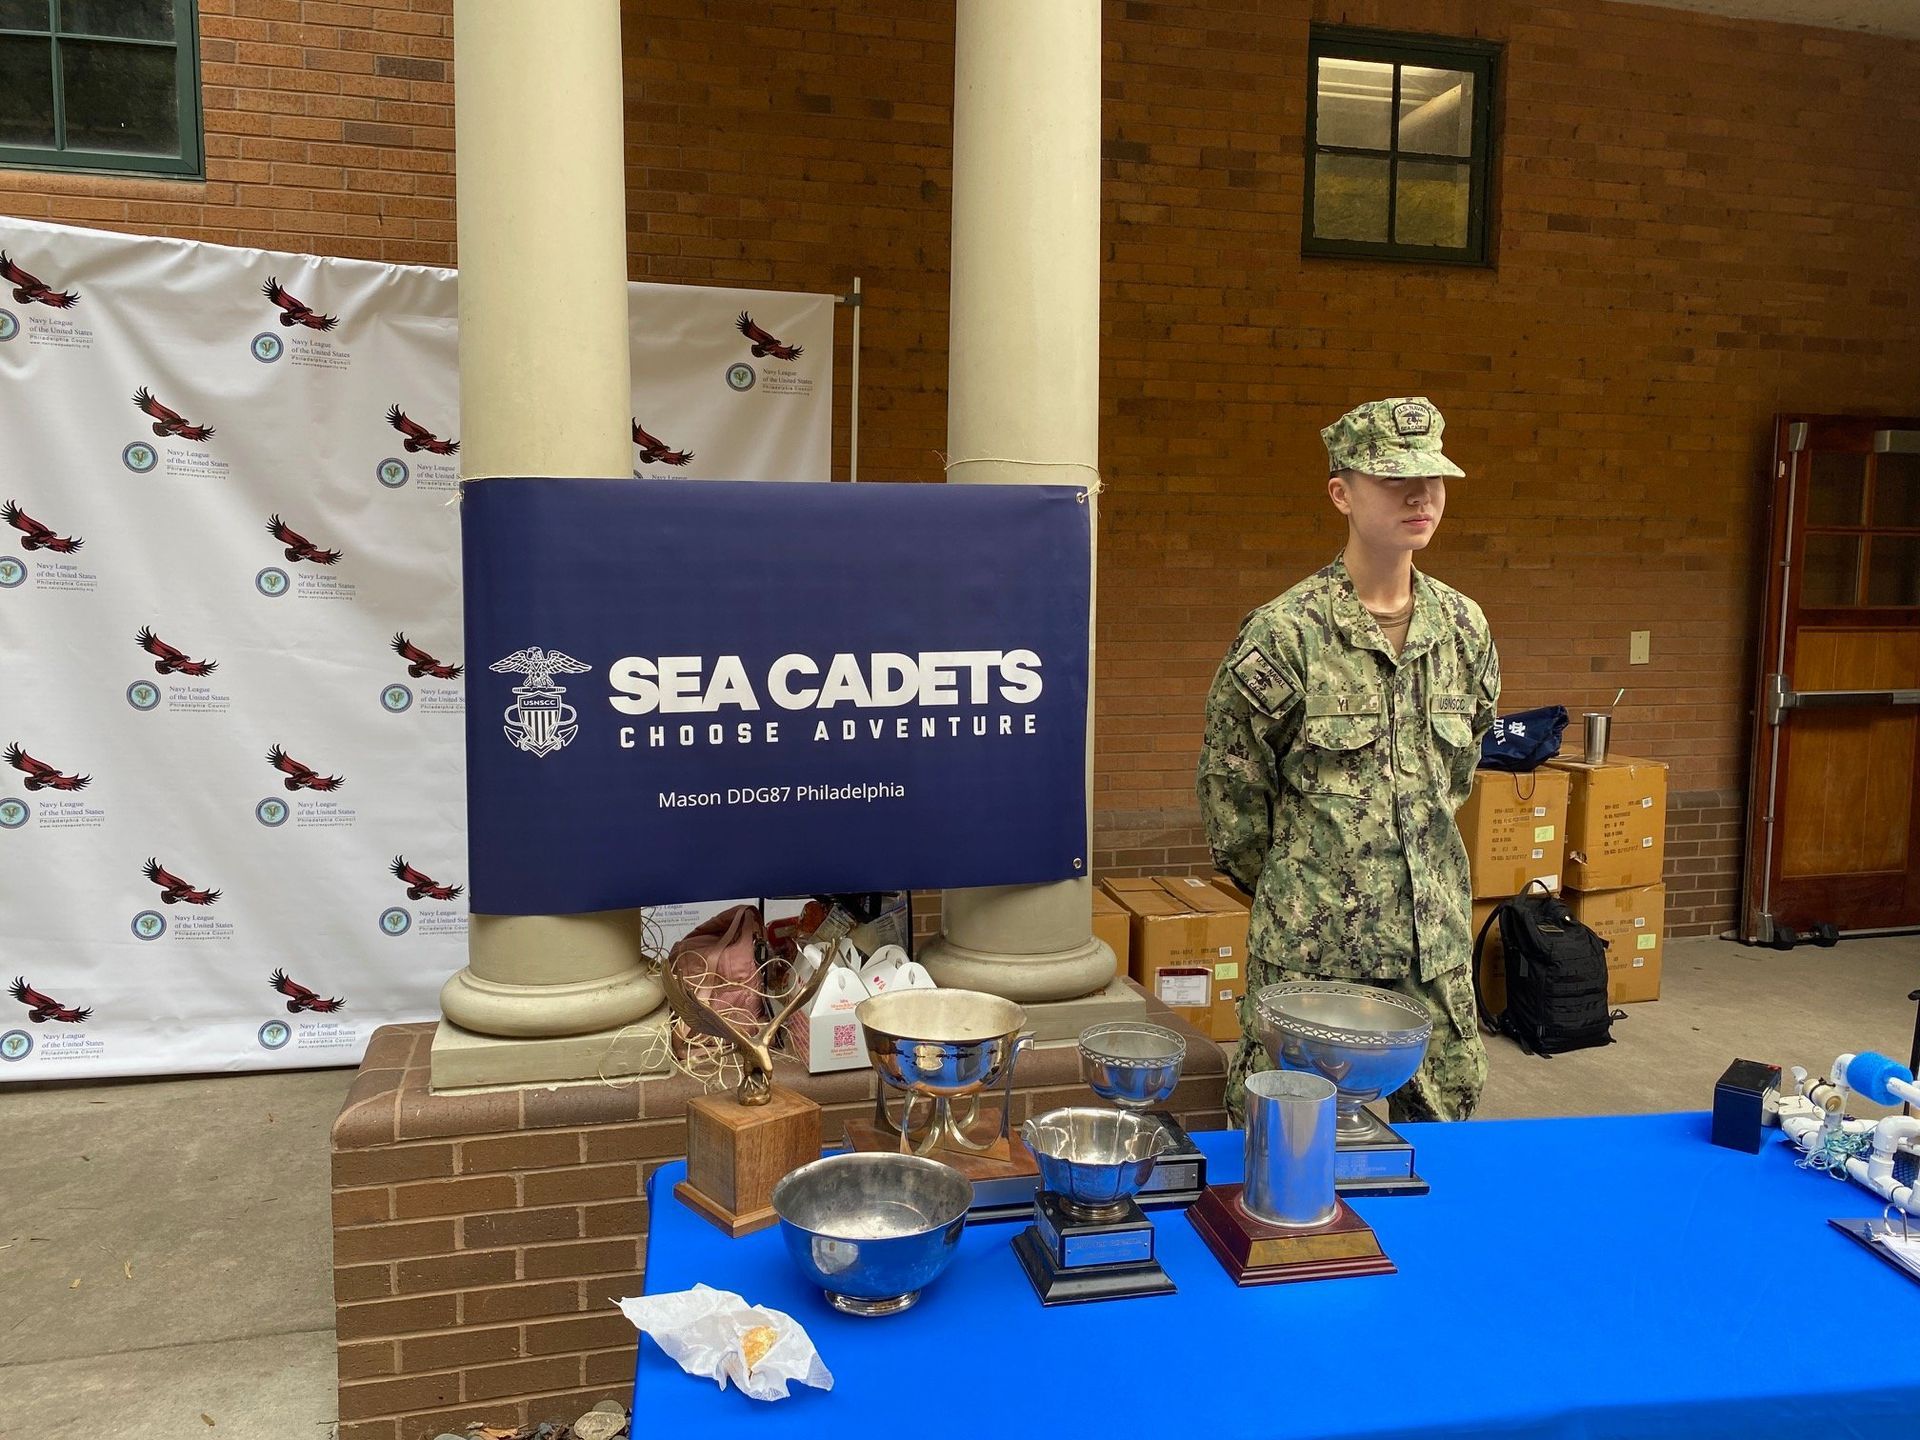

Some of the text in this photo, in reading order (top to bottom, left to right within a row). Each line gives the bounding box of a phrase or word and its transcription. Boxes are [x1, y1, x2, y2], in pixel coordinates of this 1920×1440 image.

[292, 338, 308, 346] Navy
[168, 449, 184, 457] Navy
[608, 648, 1044, 715] SEA CADETS
[1240, 672, 1249, 684] SEA
[1267, 669, 1285, 689] NAVAL
[1338, 698, 1349, 712] YI
[1440, 698, 1465, 710] USNSCC
[620, 714, 1038, 749] CHOOSE ADVENTURE
[658, 781, 905, 809] Mason DDG87 Philadelphia
